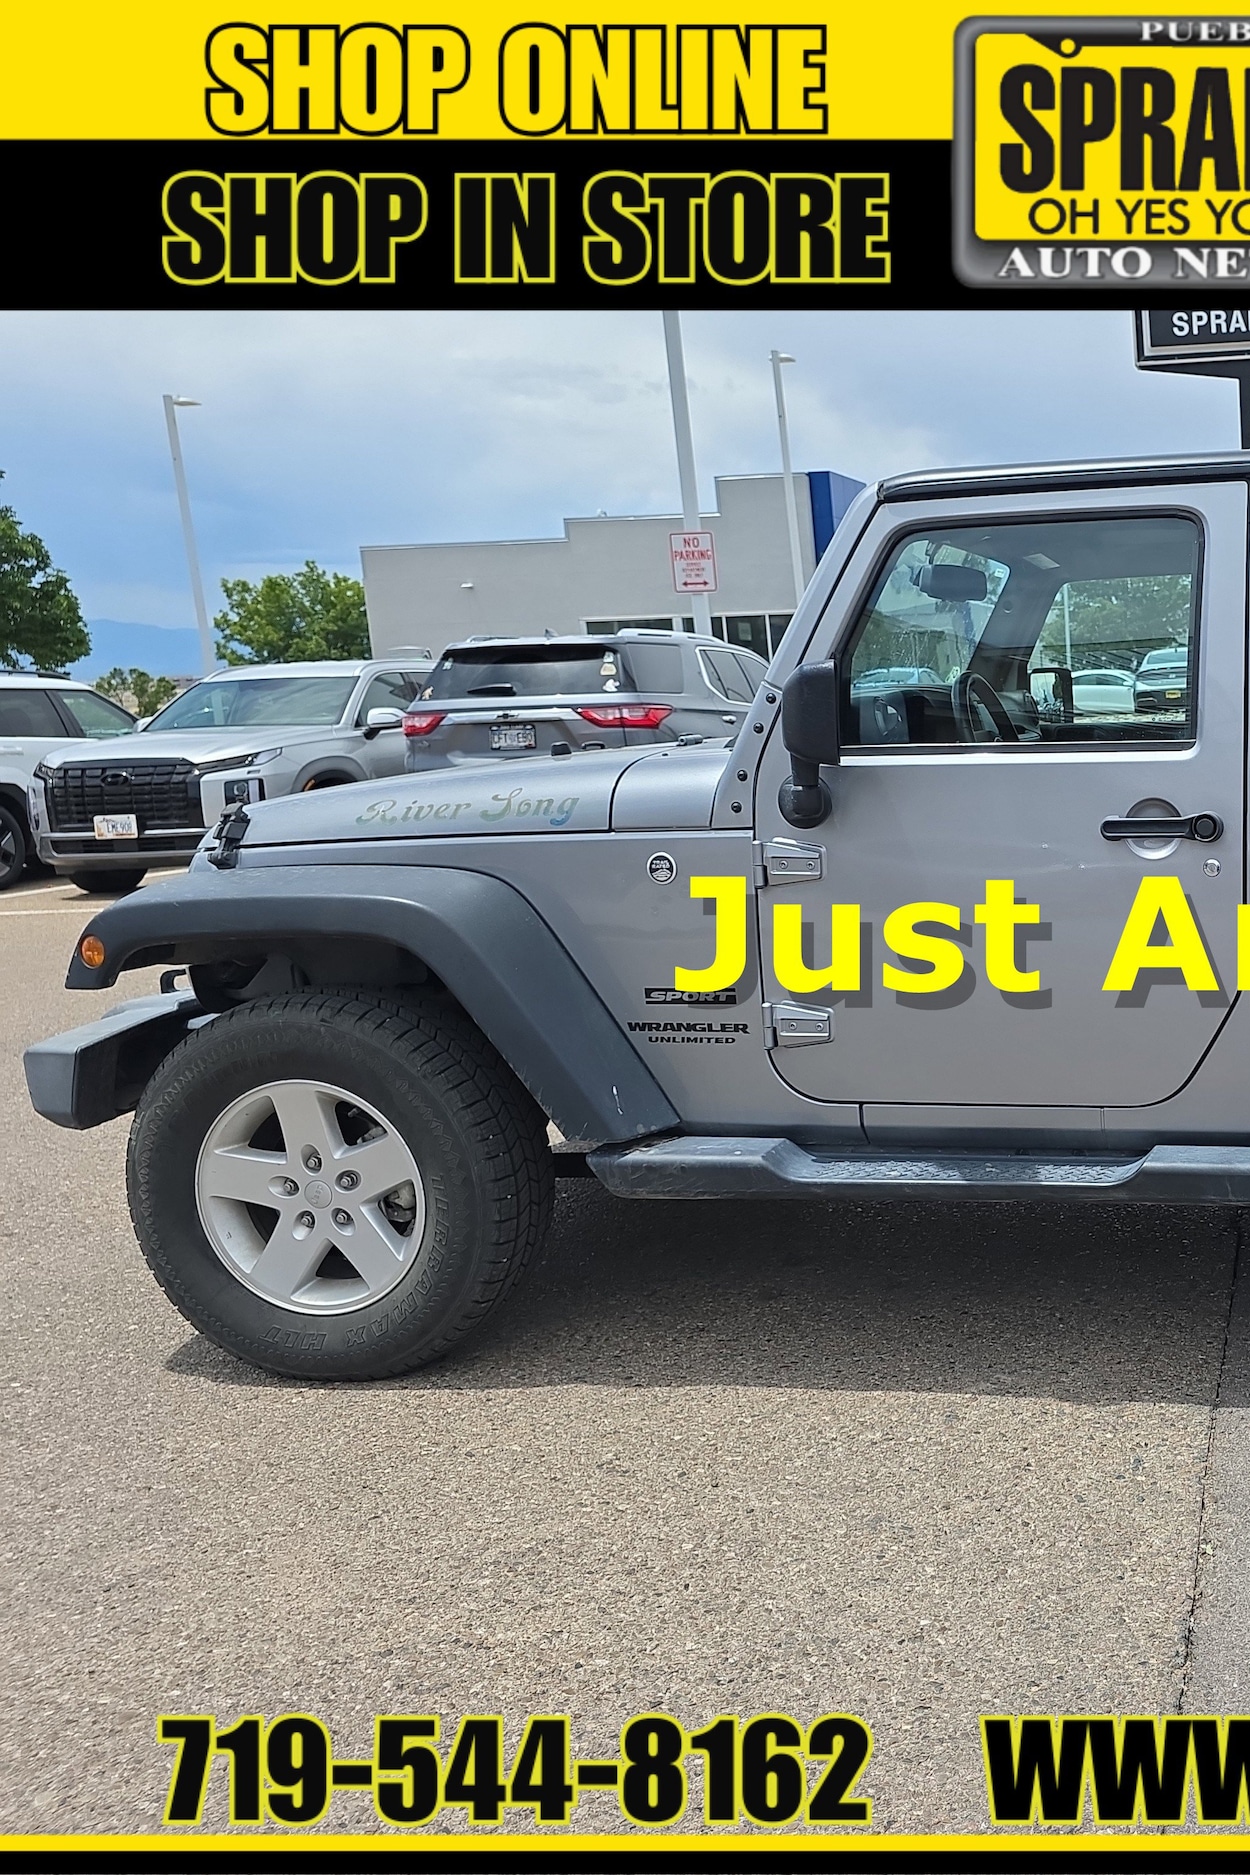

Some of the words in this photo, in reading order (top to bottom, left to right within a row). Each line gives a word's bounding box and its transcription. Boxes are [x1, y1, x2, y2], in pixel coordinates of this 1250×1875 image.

[682, 537, 700, 549] NO
[673, 549, 712, 561] PARKING
[355, 799, 472, 826] River
[479, 787, 580, 826] Song
[649, 991, 730, 1002] SPORT
[627, 1022, 750, 1034] WRANGLER
[648, 1036, 736, 1044] UNLIMITED
[345, 1173, 449, 1348] TERRAMAX
[258, 1324, 328, 1351] HLT
